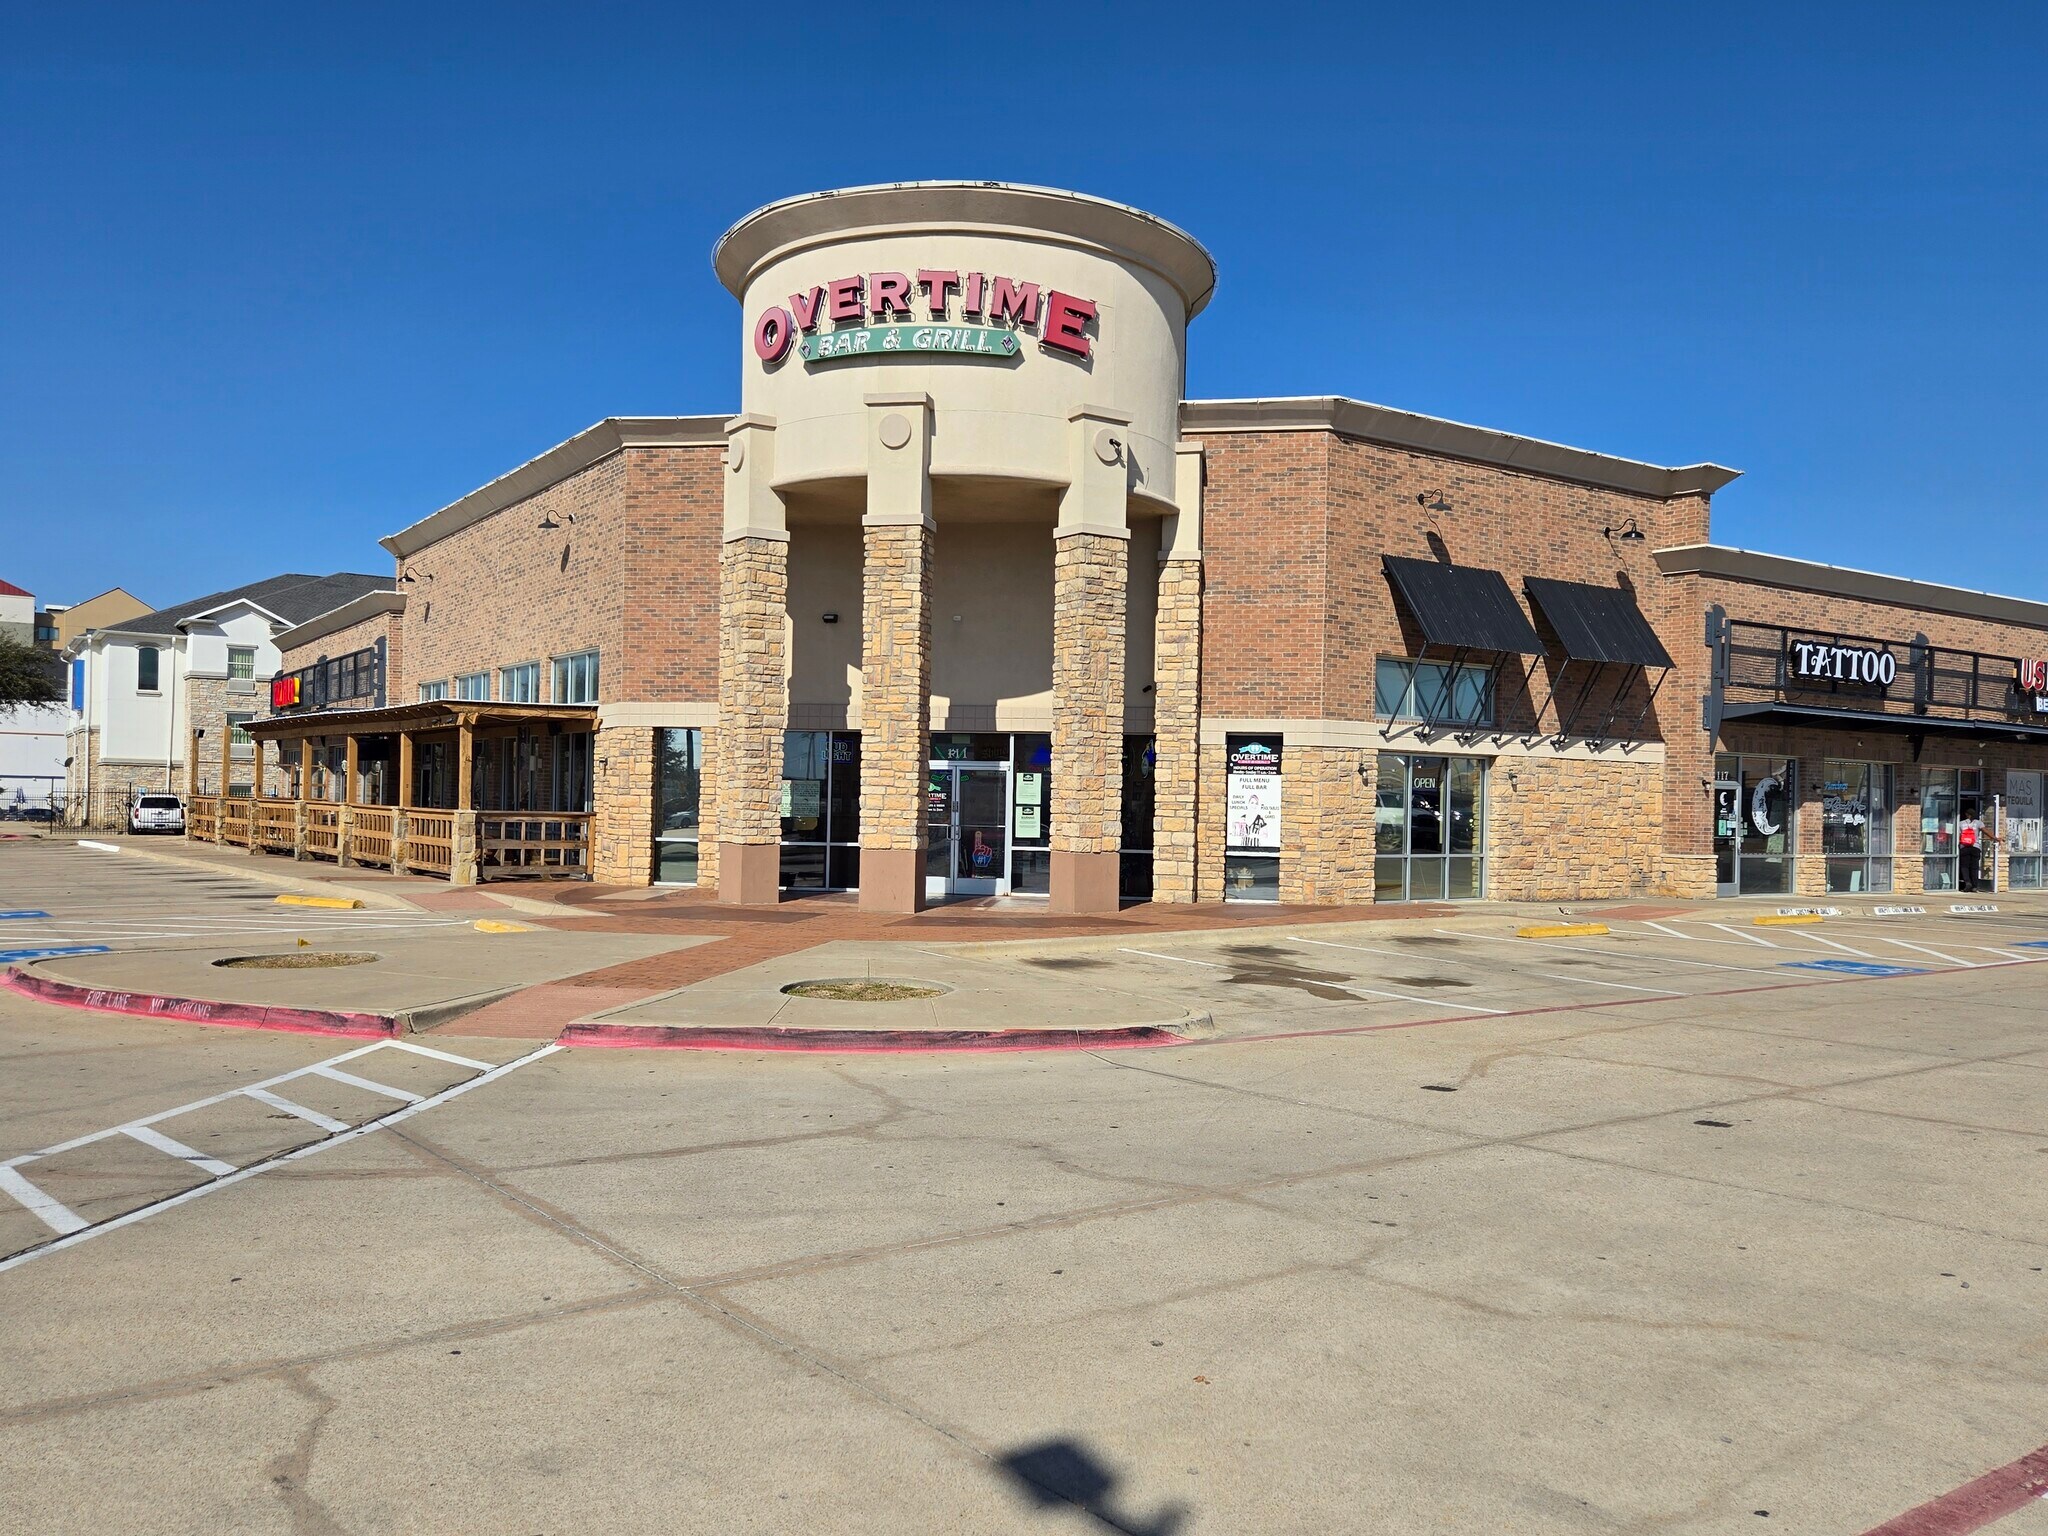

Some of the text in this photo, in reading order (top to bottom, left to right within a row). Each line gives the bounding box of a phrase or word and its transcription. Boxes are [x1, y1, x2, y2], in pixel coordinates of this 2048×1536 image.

[754, 269, 1098, 363] OVERTIME
[818, 328, 992, 357] BAR & GRILL
[1795, 642, 1896, 685] TATTOO
[2021, 658, 2048, 691] US
[821, 750, 852, 761] LGHT
[1231, 753, 1279, 763] OVERTIME
[1413, 777, 1436, 789] OPEN
[1717, 771, 1729, 781] 117
[2009, 779, 2032, 796] MAS
[2007, 796, 2034, 806] TEQUILA
[978, 856, 986, 864] #1
[85, 990, 106, 1005] FIRE
[106, 992, 131, 1010] LANE
[149, 997, 164, 1014] NO
